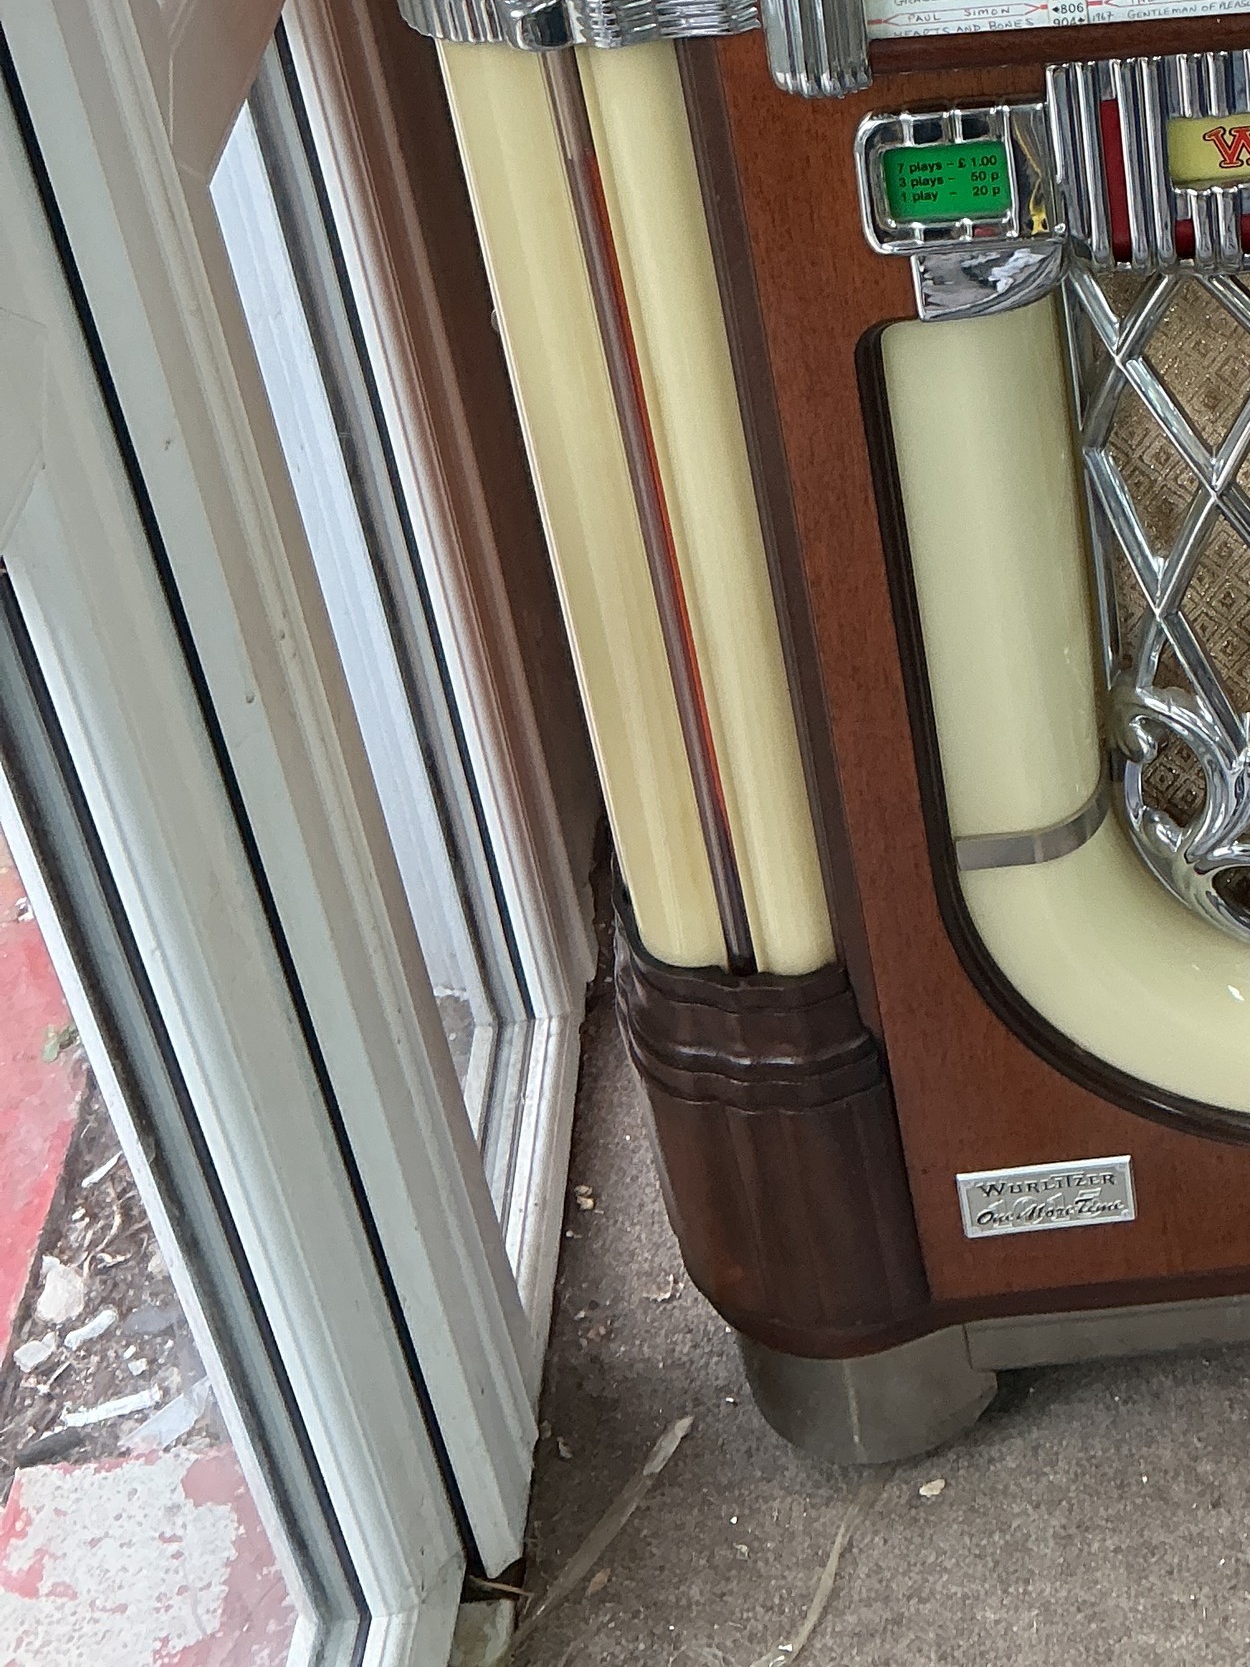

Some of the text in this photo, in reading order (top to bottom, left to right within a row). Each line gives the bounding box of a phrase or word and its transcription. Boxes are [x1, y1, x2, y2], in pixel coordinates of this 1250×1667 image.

[1061, 3, 1084, 14] 806
[908, 13, 941, 23] PAUL
[897, 155, 997, 174] 7 plays £ 1.00
[899, 171, 999, 188] 3 plays 50 p
[902, 186, 1000, 203] 1 play 20 p
[976, 1171, 1115, 1198] WURLITZER
[977, 1198, 1125, 1225] One More Time
